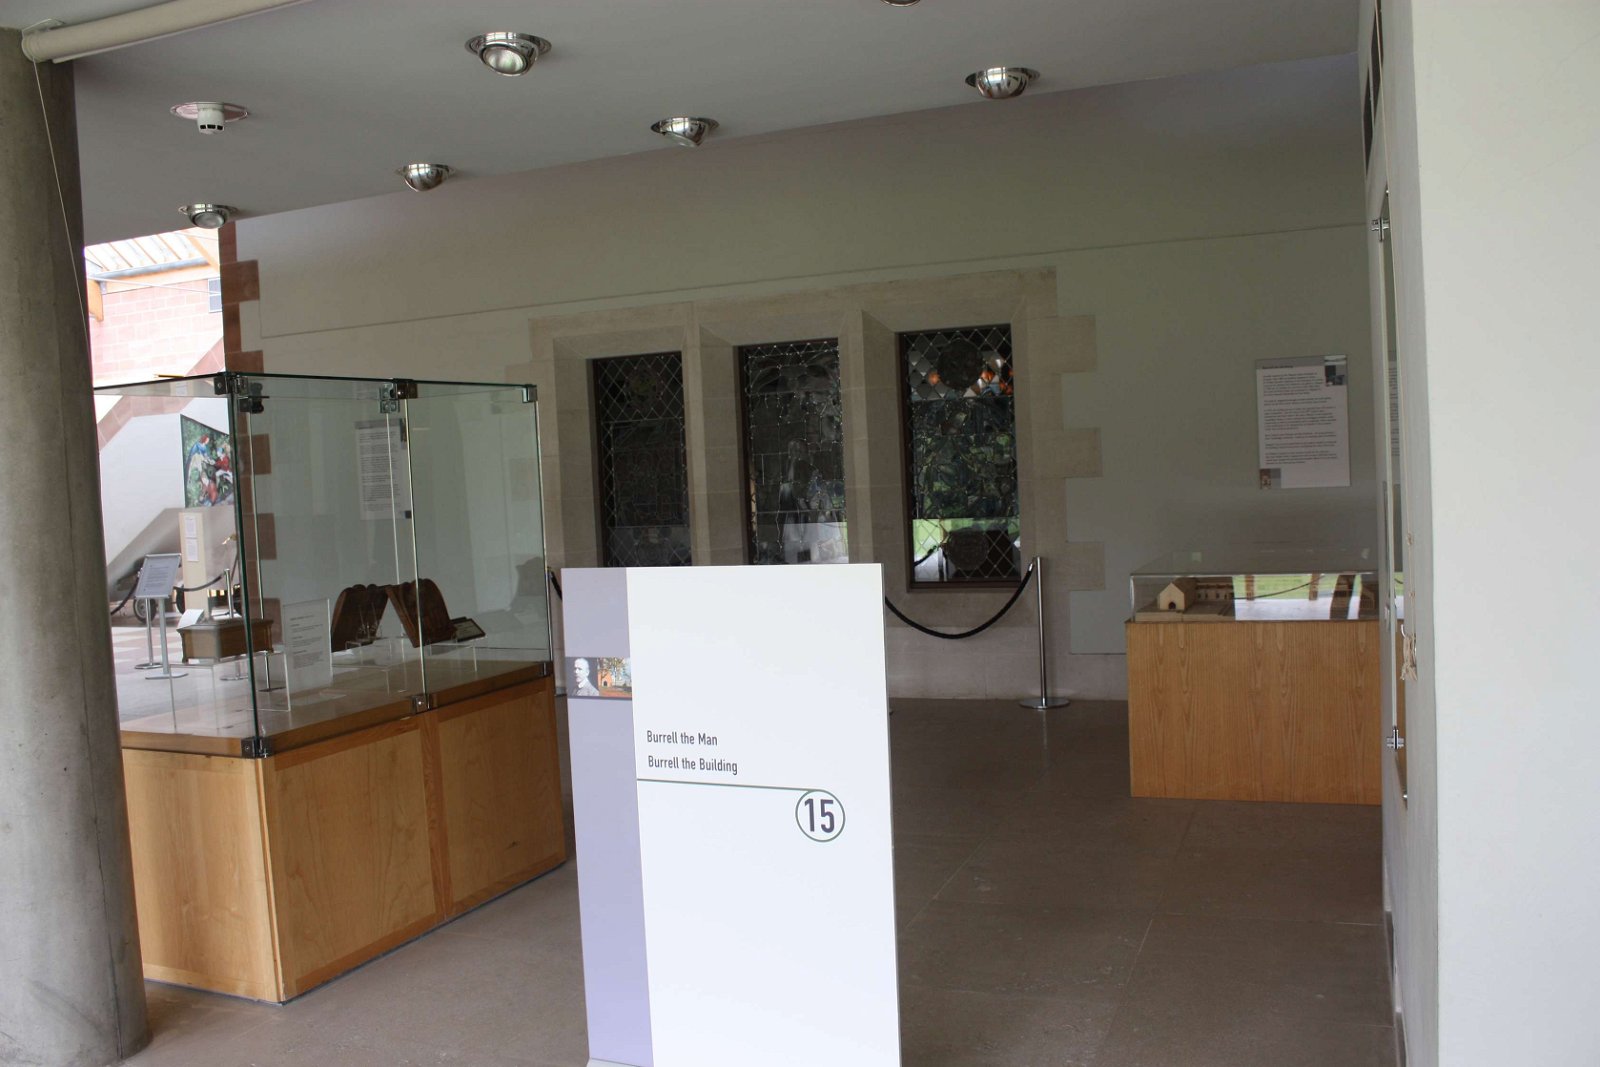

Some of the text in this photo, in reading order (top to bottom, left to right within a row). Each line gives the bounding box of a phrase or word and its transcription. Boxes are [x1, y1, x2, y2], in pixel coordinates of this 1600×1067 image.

[646, 730, 718, 746] Burrell the Man
[648, 755, 738, 776] Burrell the Building
[804, 798, 835, 834] 15
